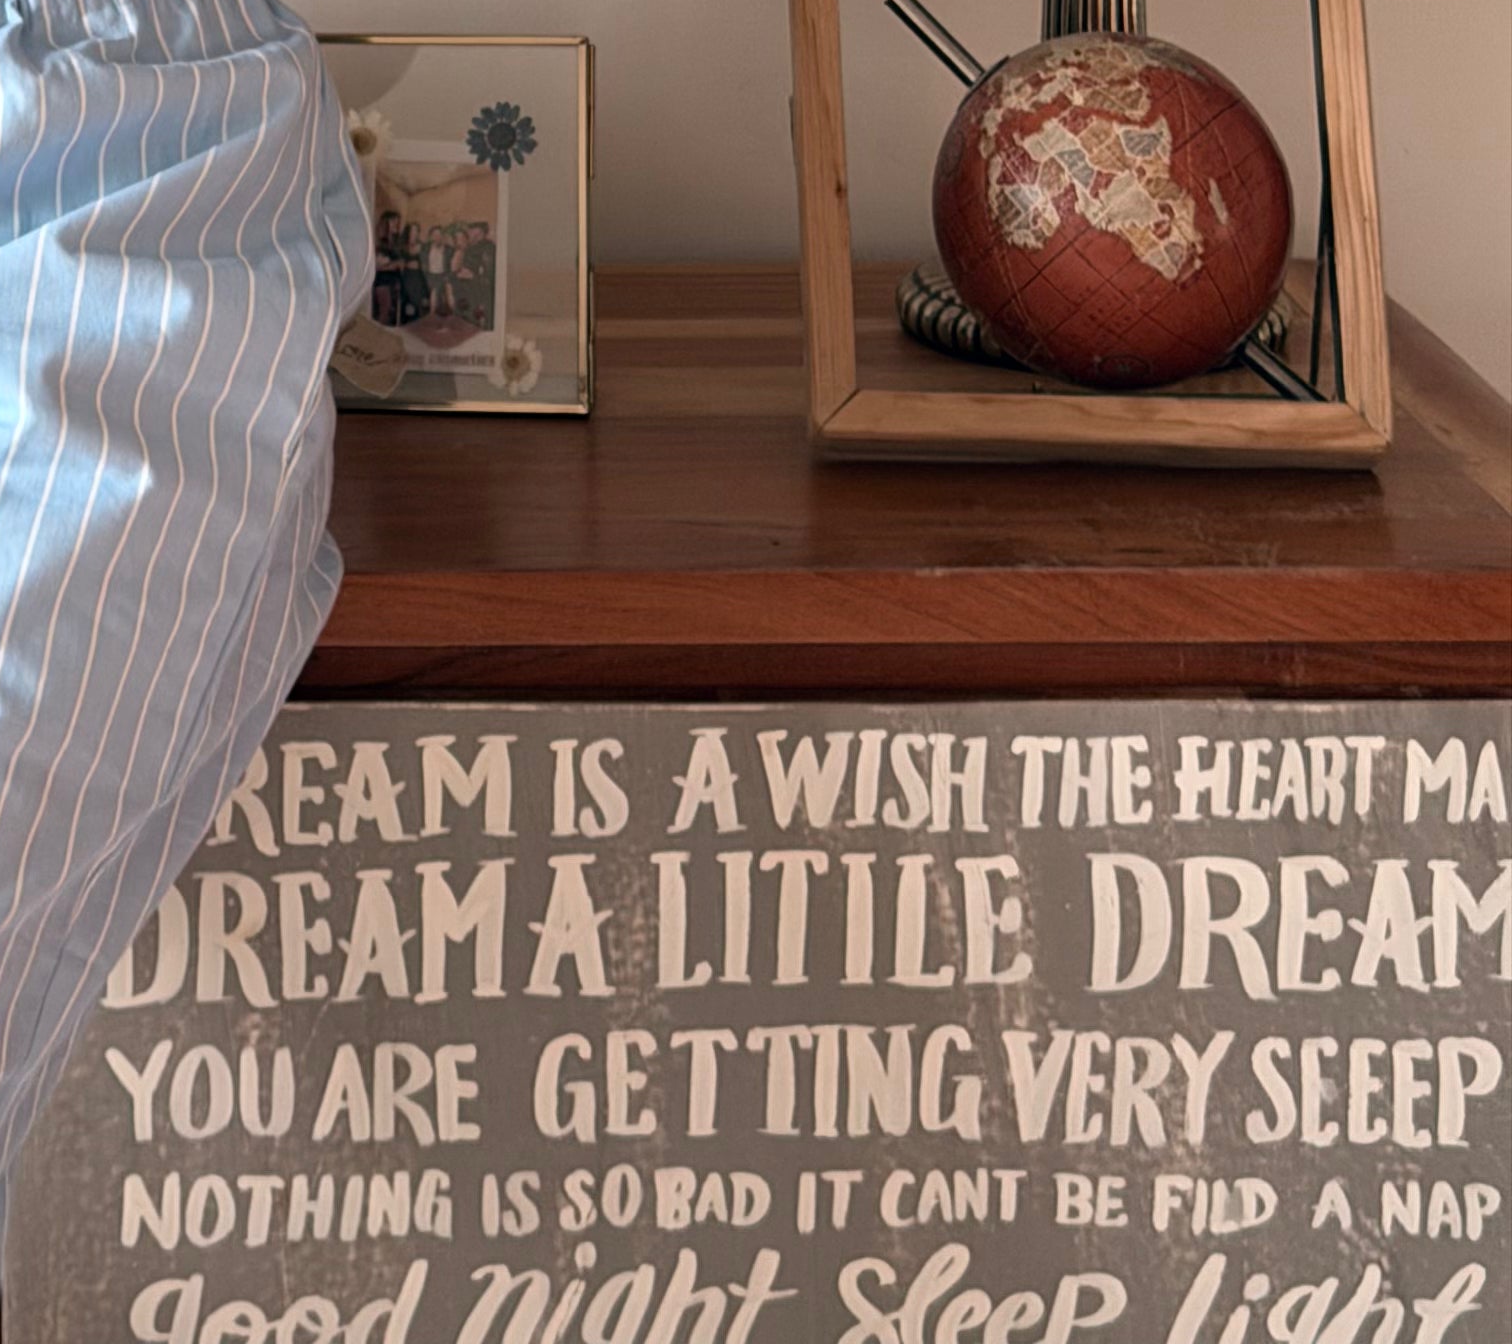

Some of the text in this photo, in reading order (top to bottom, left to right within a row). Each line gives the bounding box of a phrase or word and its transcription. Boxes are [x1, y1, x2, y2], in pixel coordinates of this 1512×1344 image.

[549, 738, 630, 839] IS
[667, 727, 748, 834] A
[756, 729, 990, 833] WISH
[1011, 734, 1153, 829] THE
[1172, 735, 1386, 825] HEART
[99, 858, 515, 1010] DREAM
[524, 853, 616, 998] A
[1085, 852, 1512, 1002] DREAM
[104, 1039, 296, 1142] YOU
[311, 1042, 481, 1147] ARE
[533, 1023, 984, 1143] GETTING
[1000, 1030, 1236, 1148] VERY
[121, 1168, 453, 1251] NOTHING
[481, 1169, 541, 1239] IS
[558, 1163, 643, 1232] SO
[654, 1166, 772, 1231] BAD
[796, 1169, 864, 1234] IT
[880, 1167, 1028, 1230] CANT
[1053, 1171, 1129, 1229] BE
[1311, 1178, 1353, 1231] A
[1381, 1179, 1501, 1242] NAP
